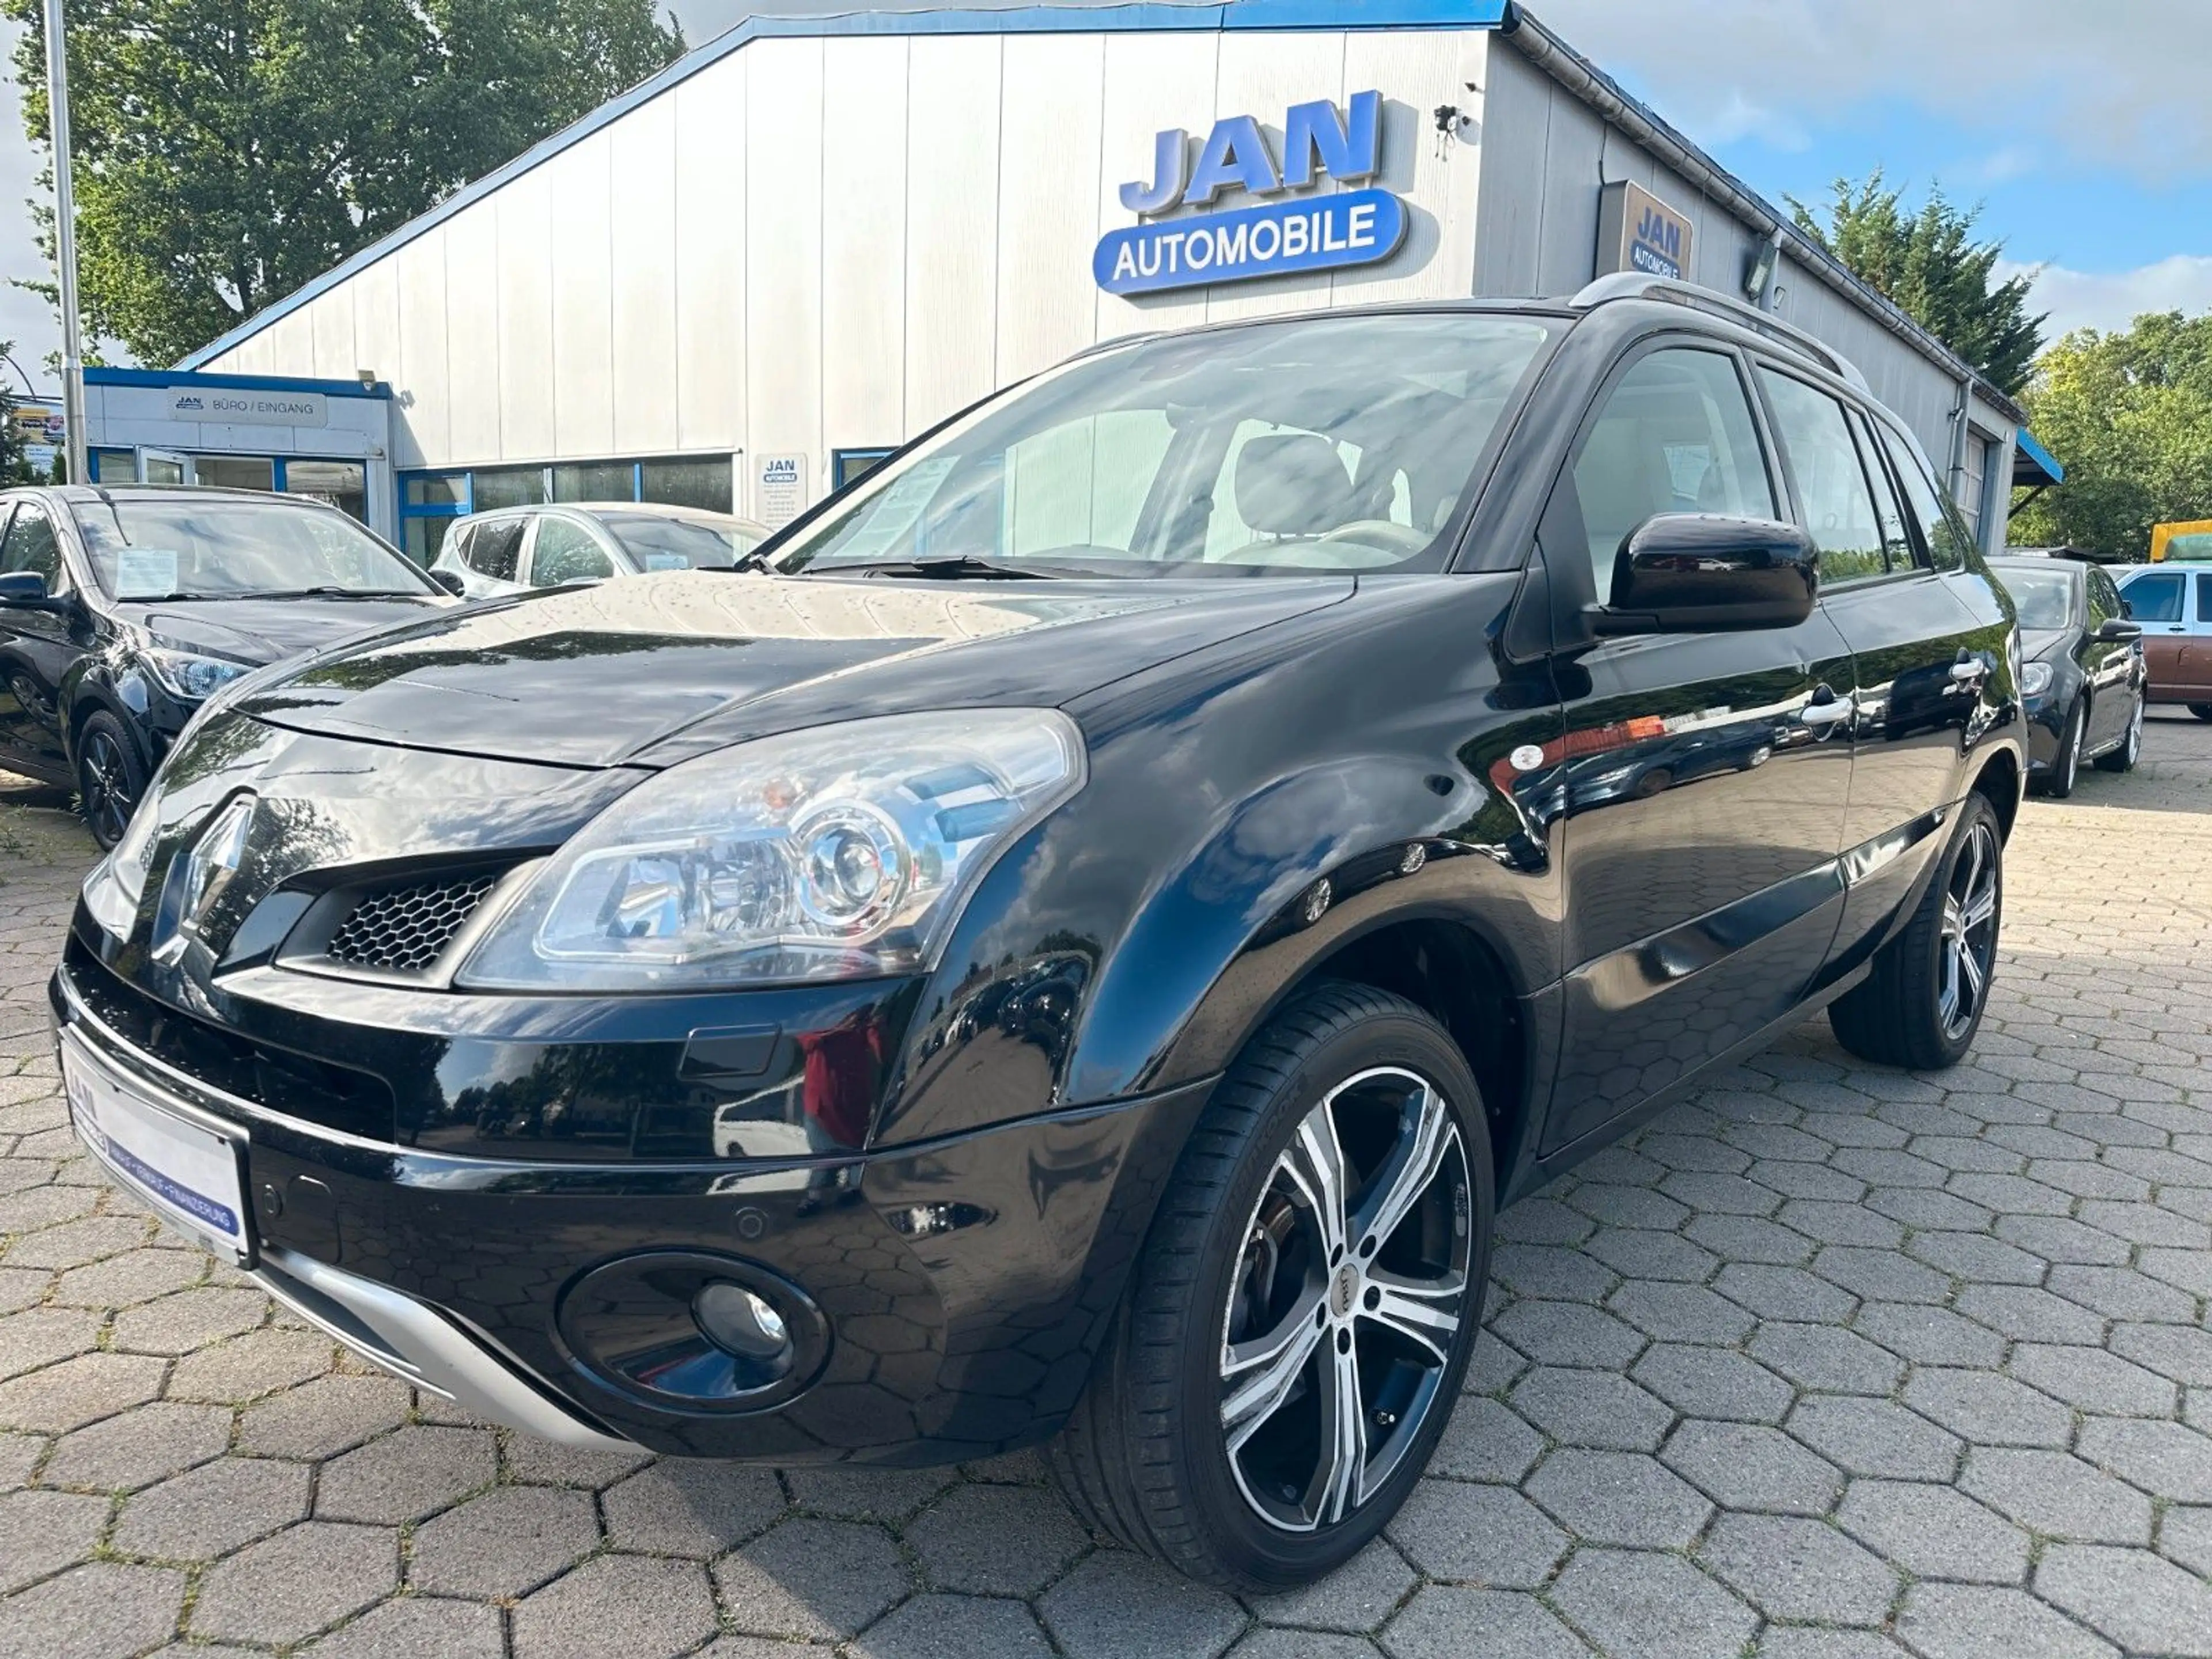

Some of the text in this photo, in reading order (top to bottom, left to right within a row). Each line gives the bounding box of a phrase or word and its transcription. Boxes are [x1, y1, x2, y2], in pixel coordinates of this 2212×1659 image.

[1119, 89, 1383, 214] JAN
[1112, 203, 1377, 281] AUTOMOBILE
[1638, 206, 1681, 258] JAN
[213, 398, 248, 411] BÜRO
[257, 402, 314, 414] EINGANG
[766, 460, 795, 472] JAN
